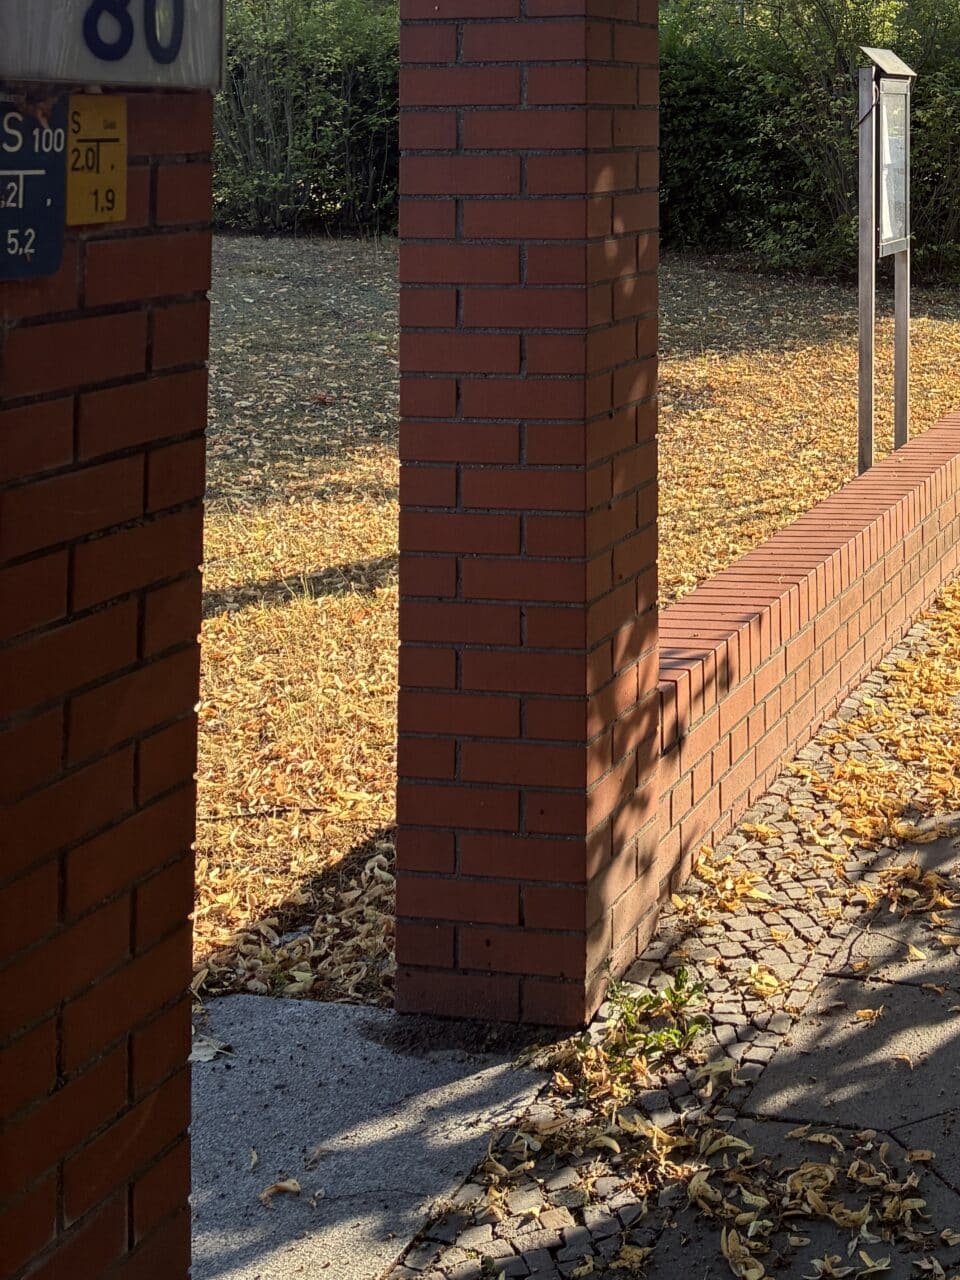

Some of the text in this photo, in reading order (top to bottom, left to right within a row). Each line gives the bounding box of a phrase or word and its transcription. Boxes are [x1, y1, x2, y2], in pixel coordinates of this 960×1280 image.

[2, 112, 65, 153] S 100
[71, 111, 81, 134] S
[90, 188, 116, 213] 1,9
[7, 228, 36, 256] 5,2
